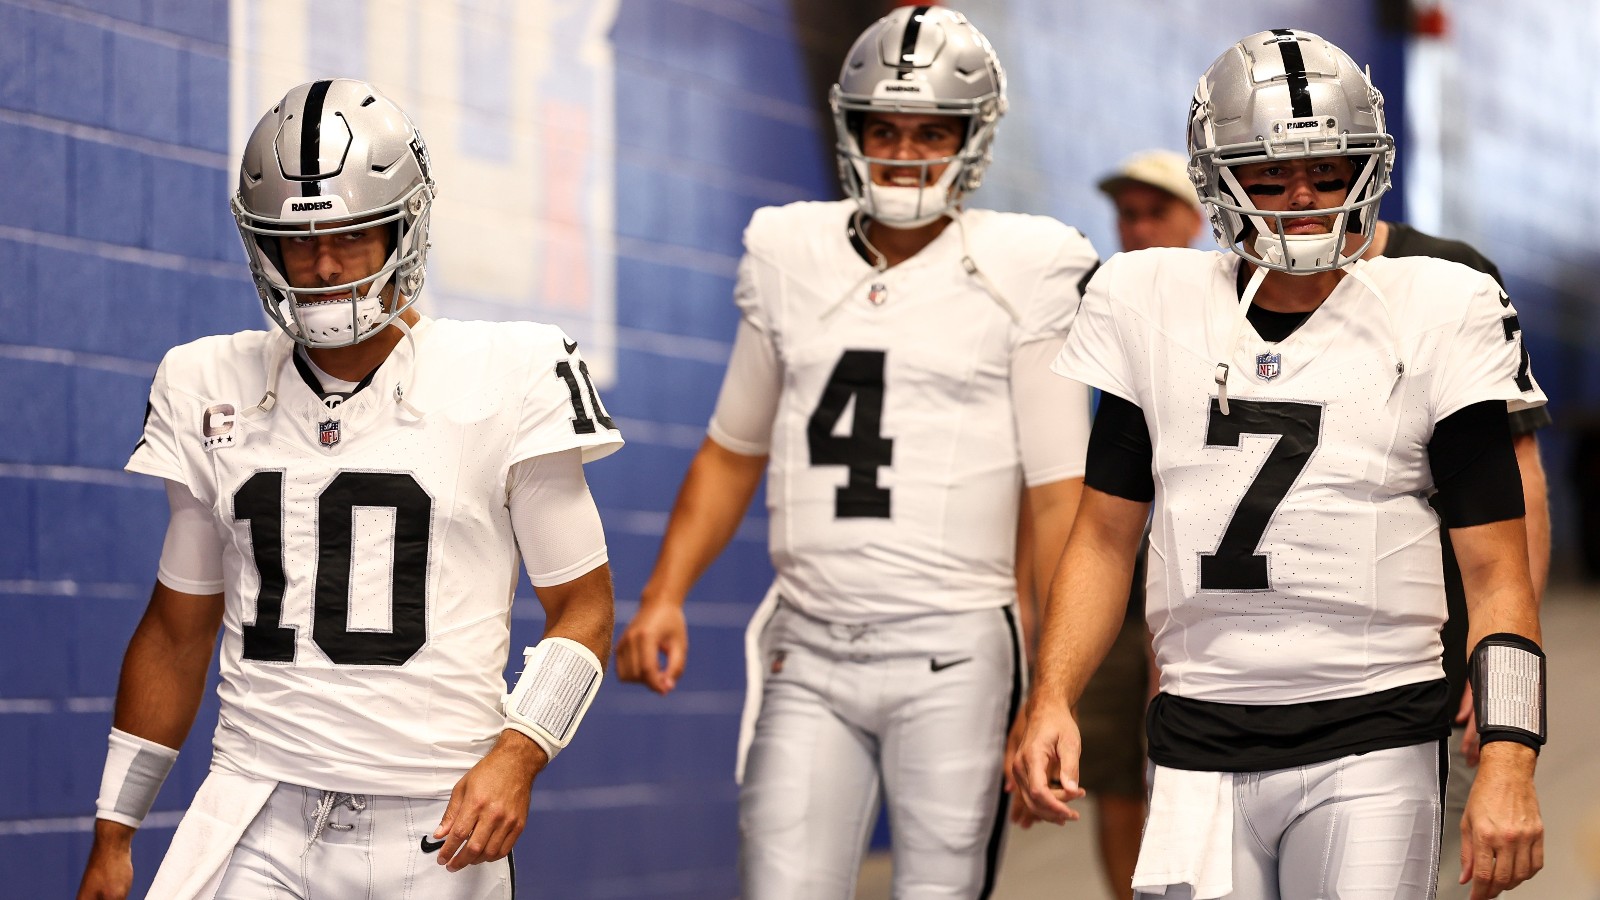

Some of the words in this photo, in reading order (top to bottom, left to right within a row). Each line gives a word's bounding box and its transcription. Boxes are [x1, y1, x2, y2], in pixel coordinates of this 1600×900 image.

[291, 200, 333, 212] RAIDERS
[1259, 364, 1277, 376] NFL
[203, 403, 235, 438] C
[321, 430, 338, 443] NFL
[807, 348, 894, 518] 4
[1197, 395, 1327, 594] 7
[231, 467, 436, 668] 10
